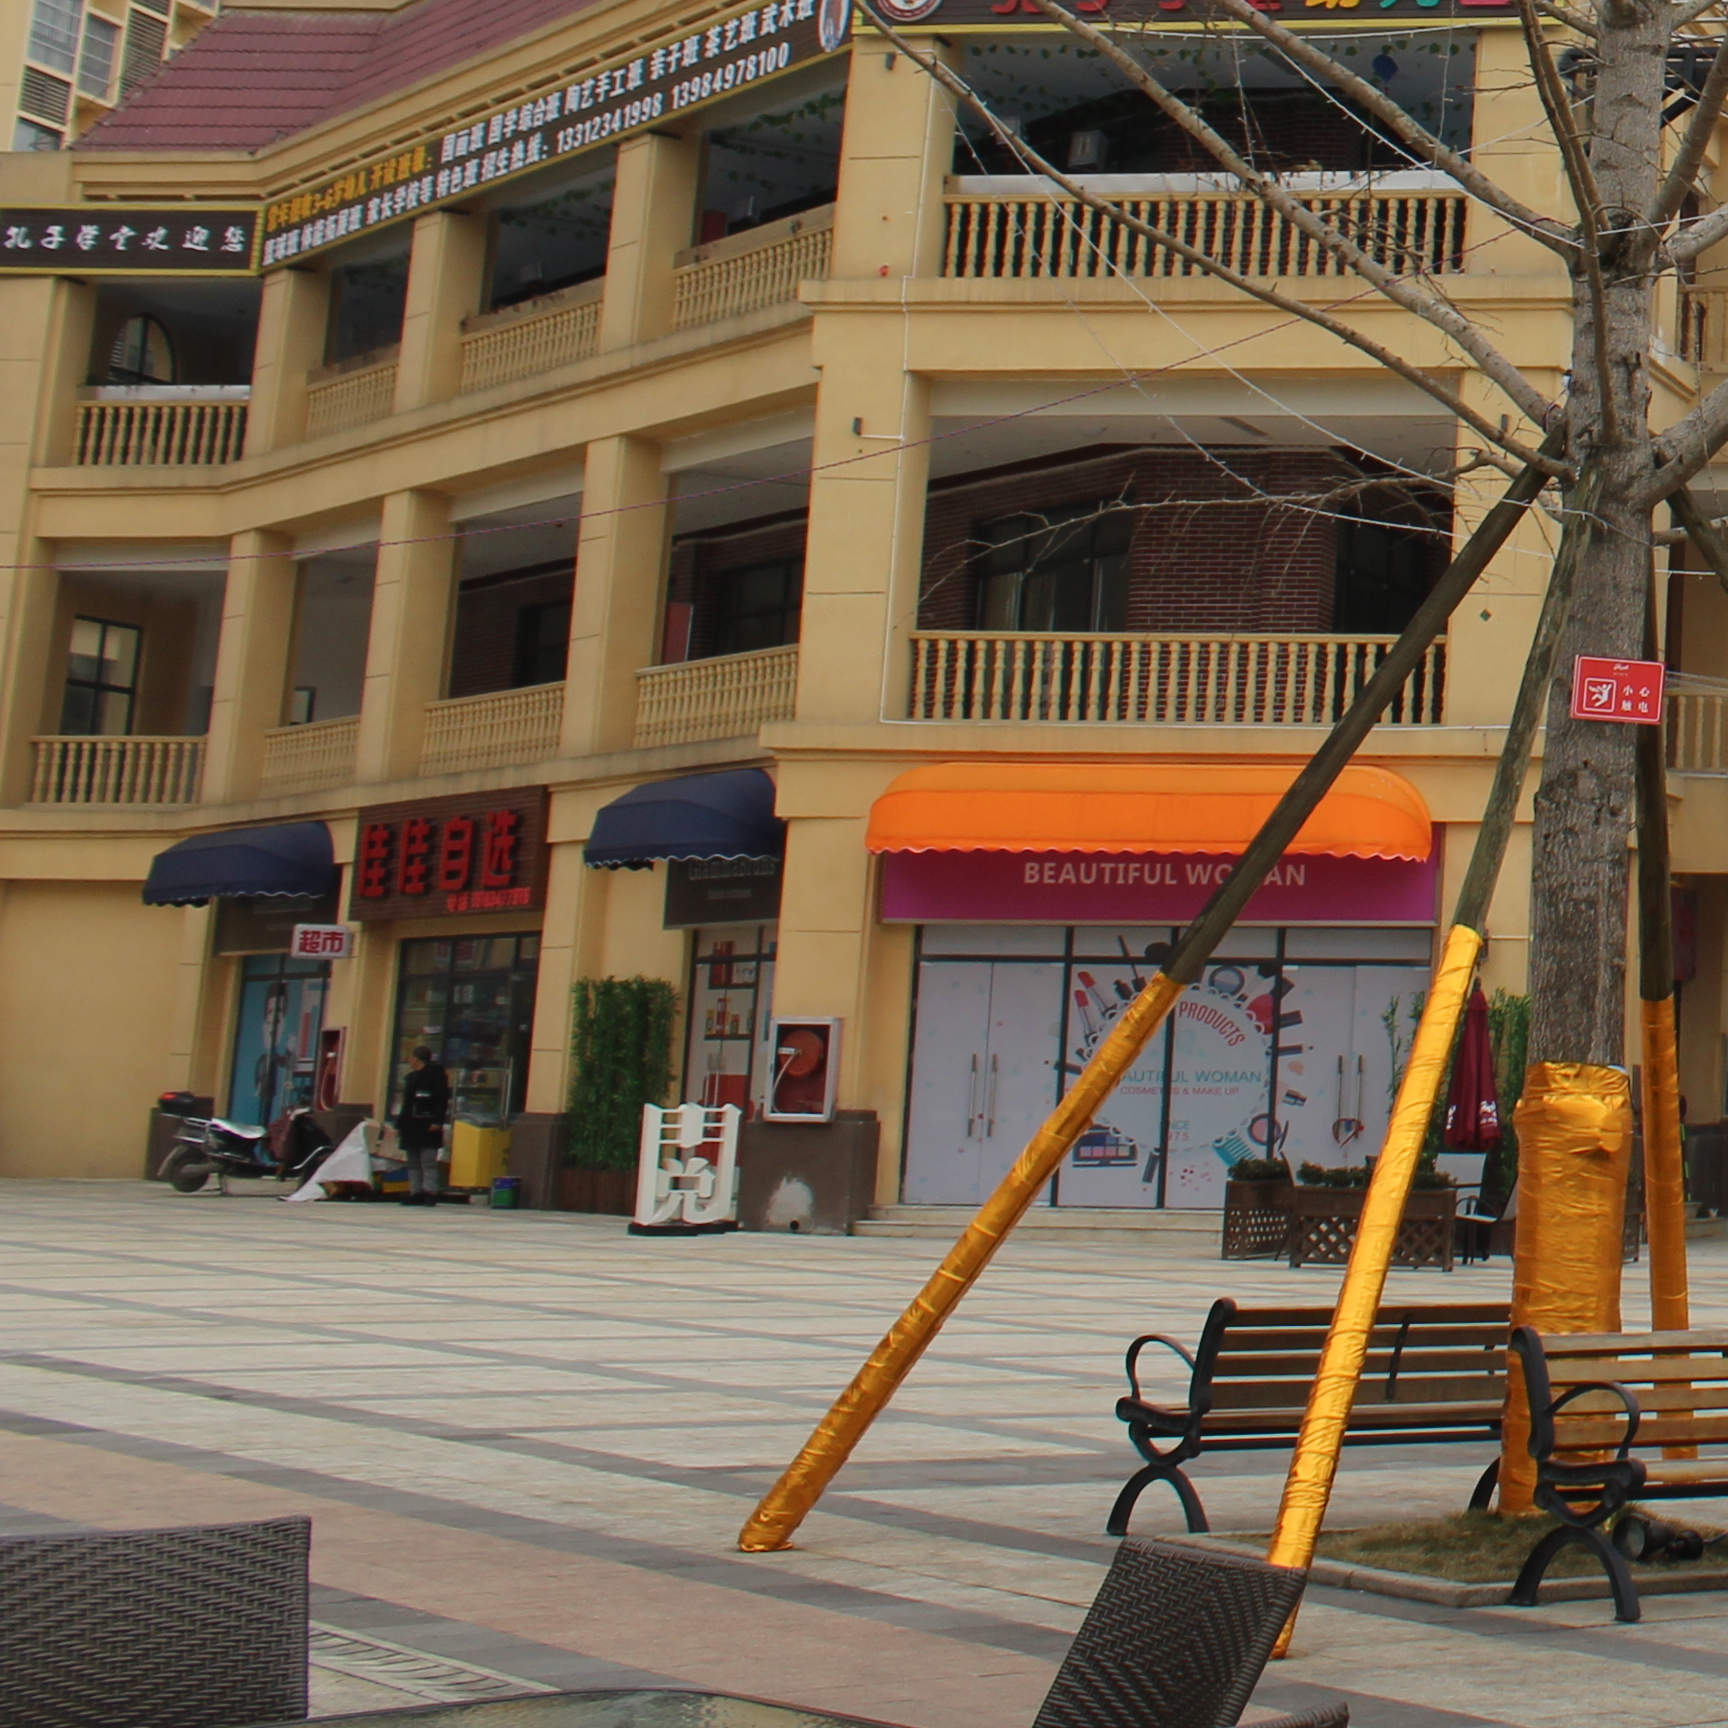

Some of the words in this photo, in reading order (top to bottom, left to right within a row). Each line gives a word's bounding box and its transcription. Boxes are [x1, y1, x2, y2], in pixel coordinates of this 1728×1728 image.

[650, 35, 701, 81] 亲子班
[557, 92, 663, 154] 13312341998
[672, 41, 793, 110] 13984978100
[1623, 684, 1651, 698] 小心
[358, 809, 520, 899] 佳佳自选
[1023, 862, 1178, 885] BEAUTIFUL
[1186, 863, 1306, 886] WOAN
[299, 929, 346, 956] 超市
[1178, 1000, 1247, 1048] PRODUCTS
[1195, 1070, 1261, 1083] WOMAN
[1192, 1086, 1222, 1096] MAKE
[1224, 1086, 1240, 1096] UP
